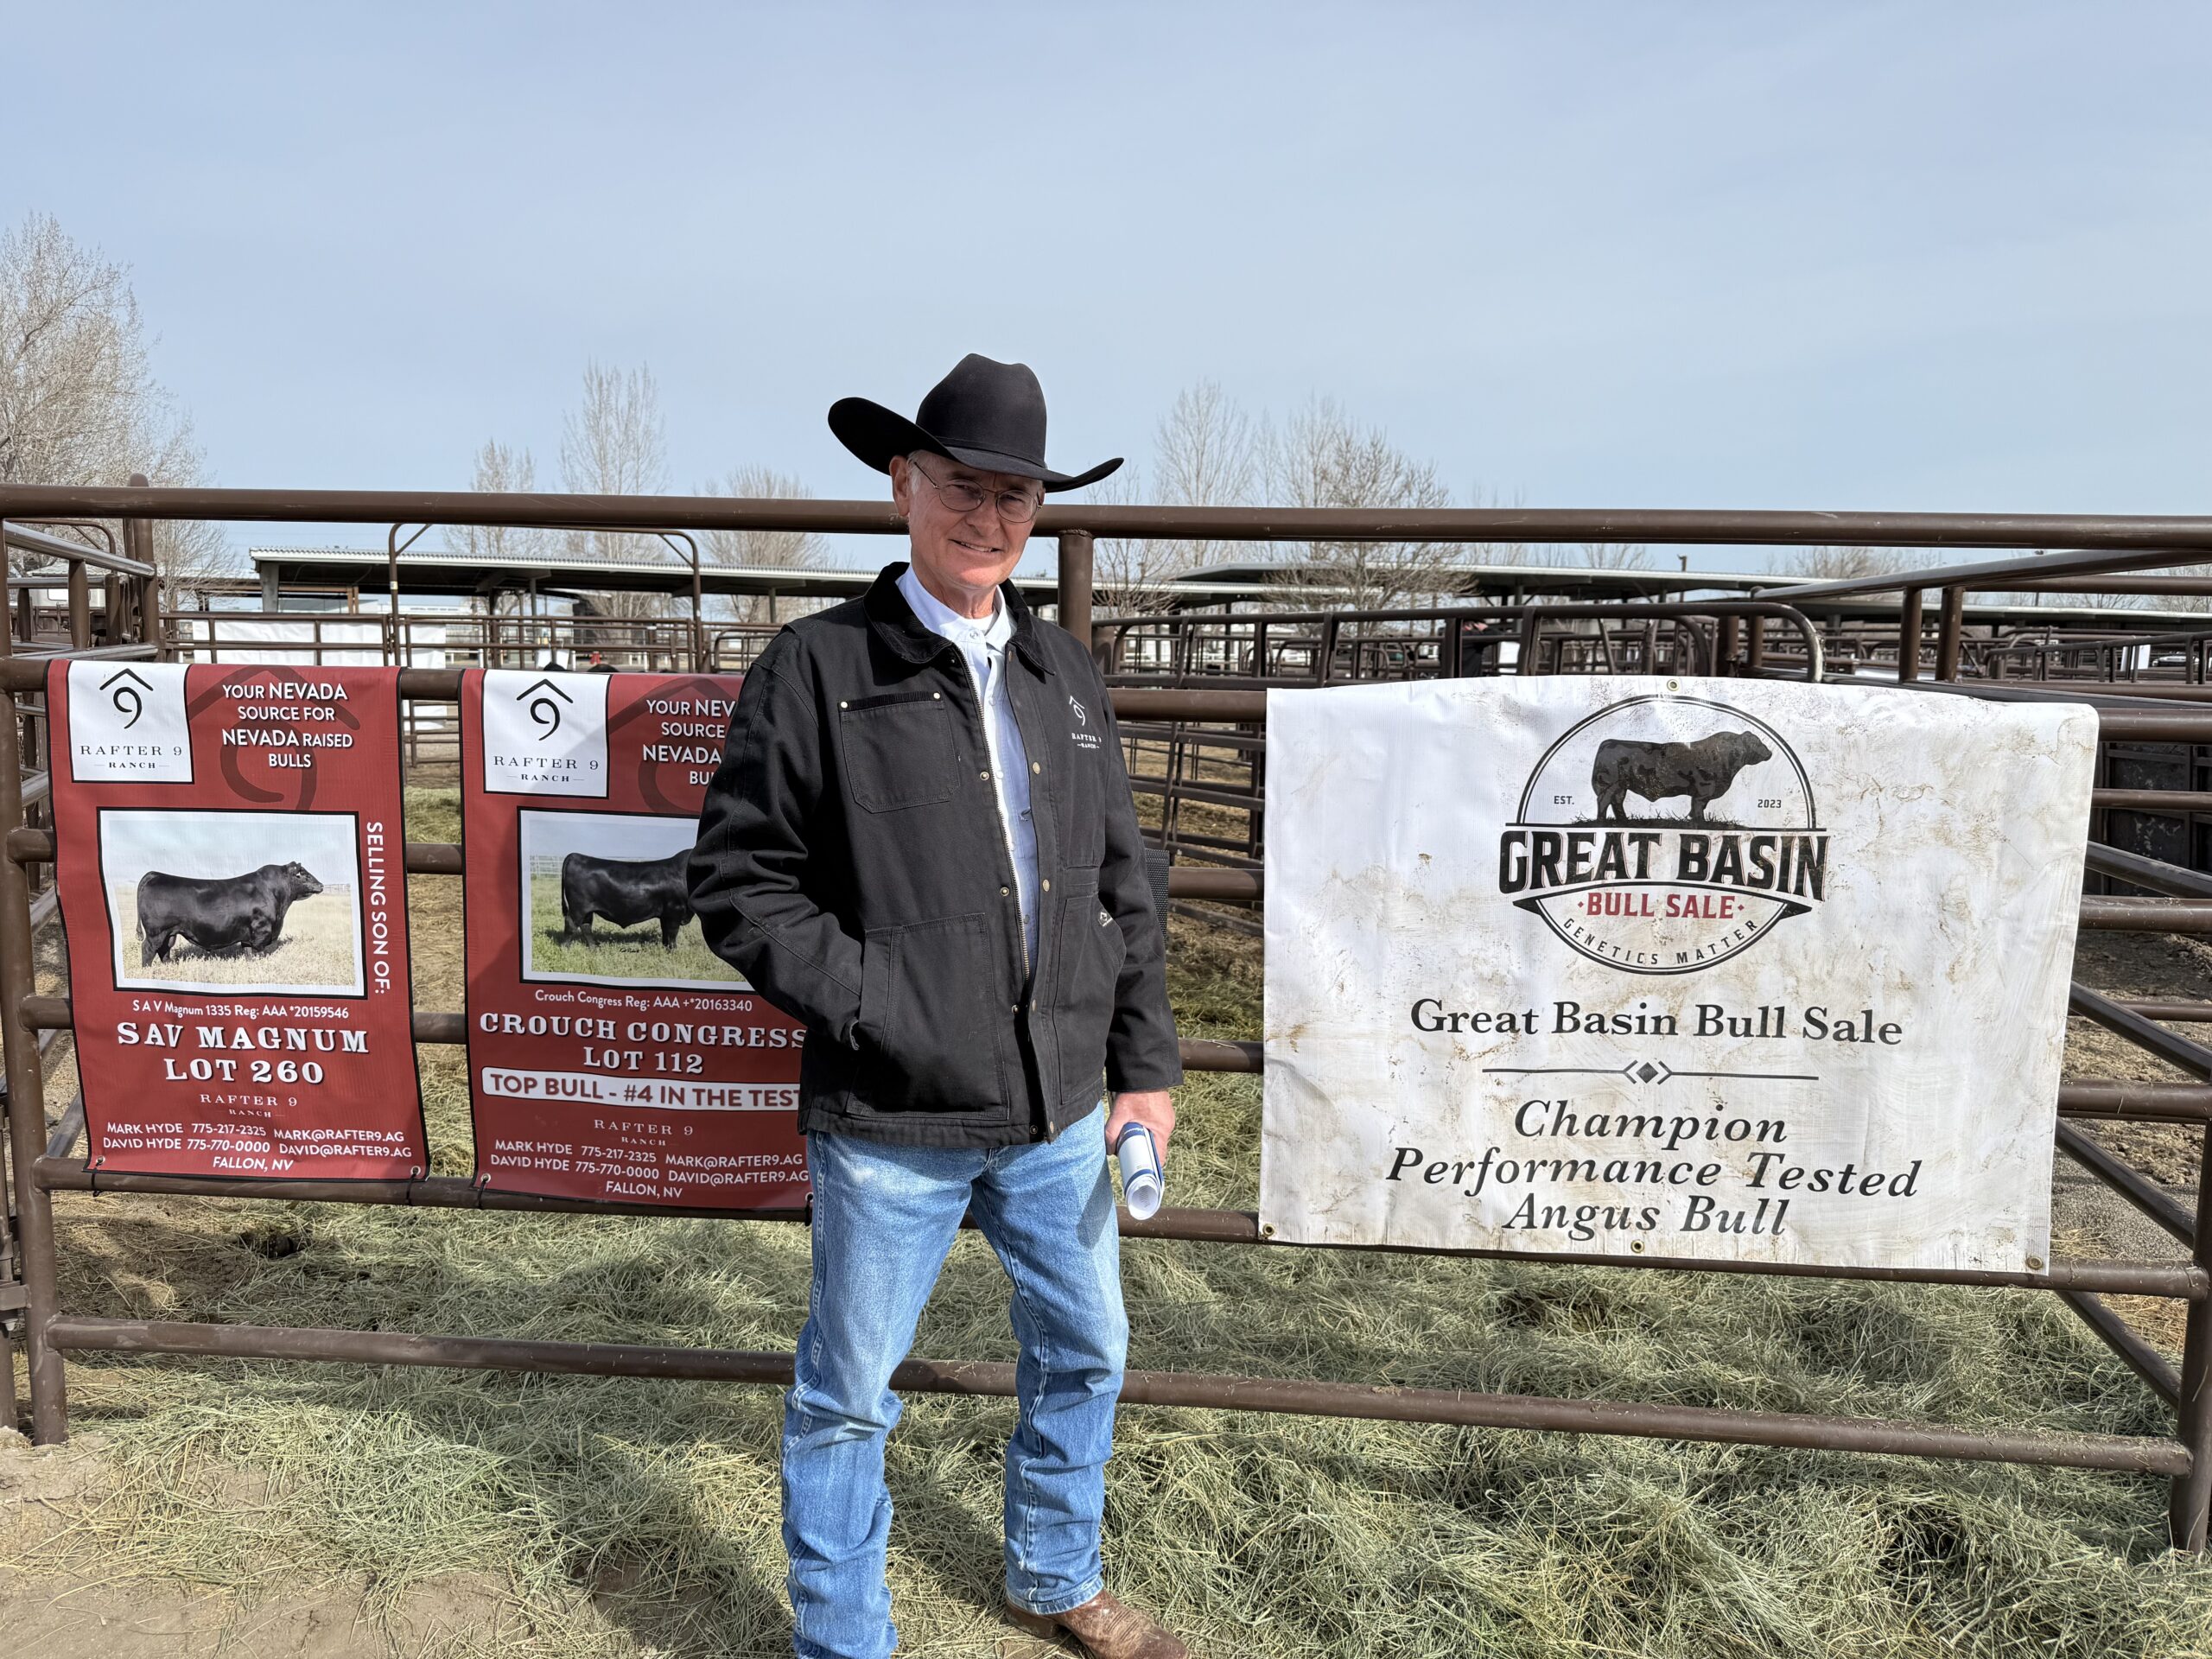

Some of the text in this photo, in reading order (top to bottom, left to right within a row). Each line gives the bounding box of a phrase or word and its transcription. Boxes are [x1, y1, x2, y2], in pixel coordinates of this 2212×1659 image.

[222, 683, 347, 701] YOUR NEVADA
[238, 706, 335, 721] SOURCE FOR
[645, 699, 735, 717] YOUR NEV
[222, 729, 353, 748] NEVADA RAISED
[661, 722, 725, 738] SOURCE
[80, 745, 182, 757] RAFTER 9
[269, 753, 312, 768] BULLS
[643, 744, 721, 764] NEVADA
[493, 755, 599, 771] RAFTER 9
[521, 773, 569, 782] RANCH
[1554, 795, 1574, 805] EST.
[1758, 798, 1782, 809] 2023
[1499, 830, 1831, 902] GREAT BASIN
[366, 822, 390, 994] SELLING SON OF:
[1586, 892, 1736, 919] BULL SALE
[1564, 918, 1758, 965] GENETICS MATTER
[132, 1000, 140, 1011] S
[142, 1000, 151, 1012] A
[153, 1001, 162, 1012] V
[165, 1001, 203, 1018] Magnum
[206, 1005, 232, 1016] 1335
[234, 1004, 259, 1020] Reg:
[263, 1004, 287, 1017] AAA
[535, 989, 575, 1003] Crouch
[577, 991, 622, 1009] Congress
[626, 995, 650, 1012] Reg:
[653, 996, 680, 1009] AAA
[480, 1012, 806, 1049] CROUCH CONGRESS
[1411, 998, 1903, 1046] Great Basin Bull Sale
[117, 1021, 369, 1053] SAV MAGNUM
[583, 1046, 703, 1074] LOT 112
[163, 1058, 324, 1084] LOT 260
[490, 1073, 537, 1094] TOP
[544, 1077, 604, 1099] BULL
[623, 1084, 653, 1103] #4
[661, 1085, 685, 1106] IN
[692, 1089, 742, 1107] THE
[200, 1094, 298, 1108] RAFTER 9
[229, 1109, 272, 1118] RANCH
[106, 1122, 404, 1142] MARK HYDE 775-217-2325 MARK@RAFTER9.AG
[594, 1119, 694, 1136] RAFTER 9
[1514, 1099, 1788, 1151] Champion
[103, 1137, 412, 1158] DAVID HYDE 775-770-0000 DAVID@RAFTER9.AG
[621, 1136, 666, 1147] RANCH
[495, 1140, 803, 1167] MARK HYDE 775-217-2325 MARK@RAFTER9.AG
[213, 1156, 294, 1172] FALLON, NV
[490, 1154, 809, 1187] DAVID HYDE 775-770-0000 DAVID@RAFTER9.AG
[1386, 1146, 1923, 1197] Performance Tested
[606, 1180, 683, 1198] FALLON, NV
[1502, 1193, 1790, 1242] Angus Bull
